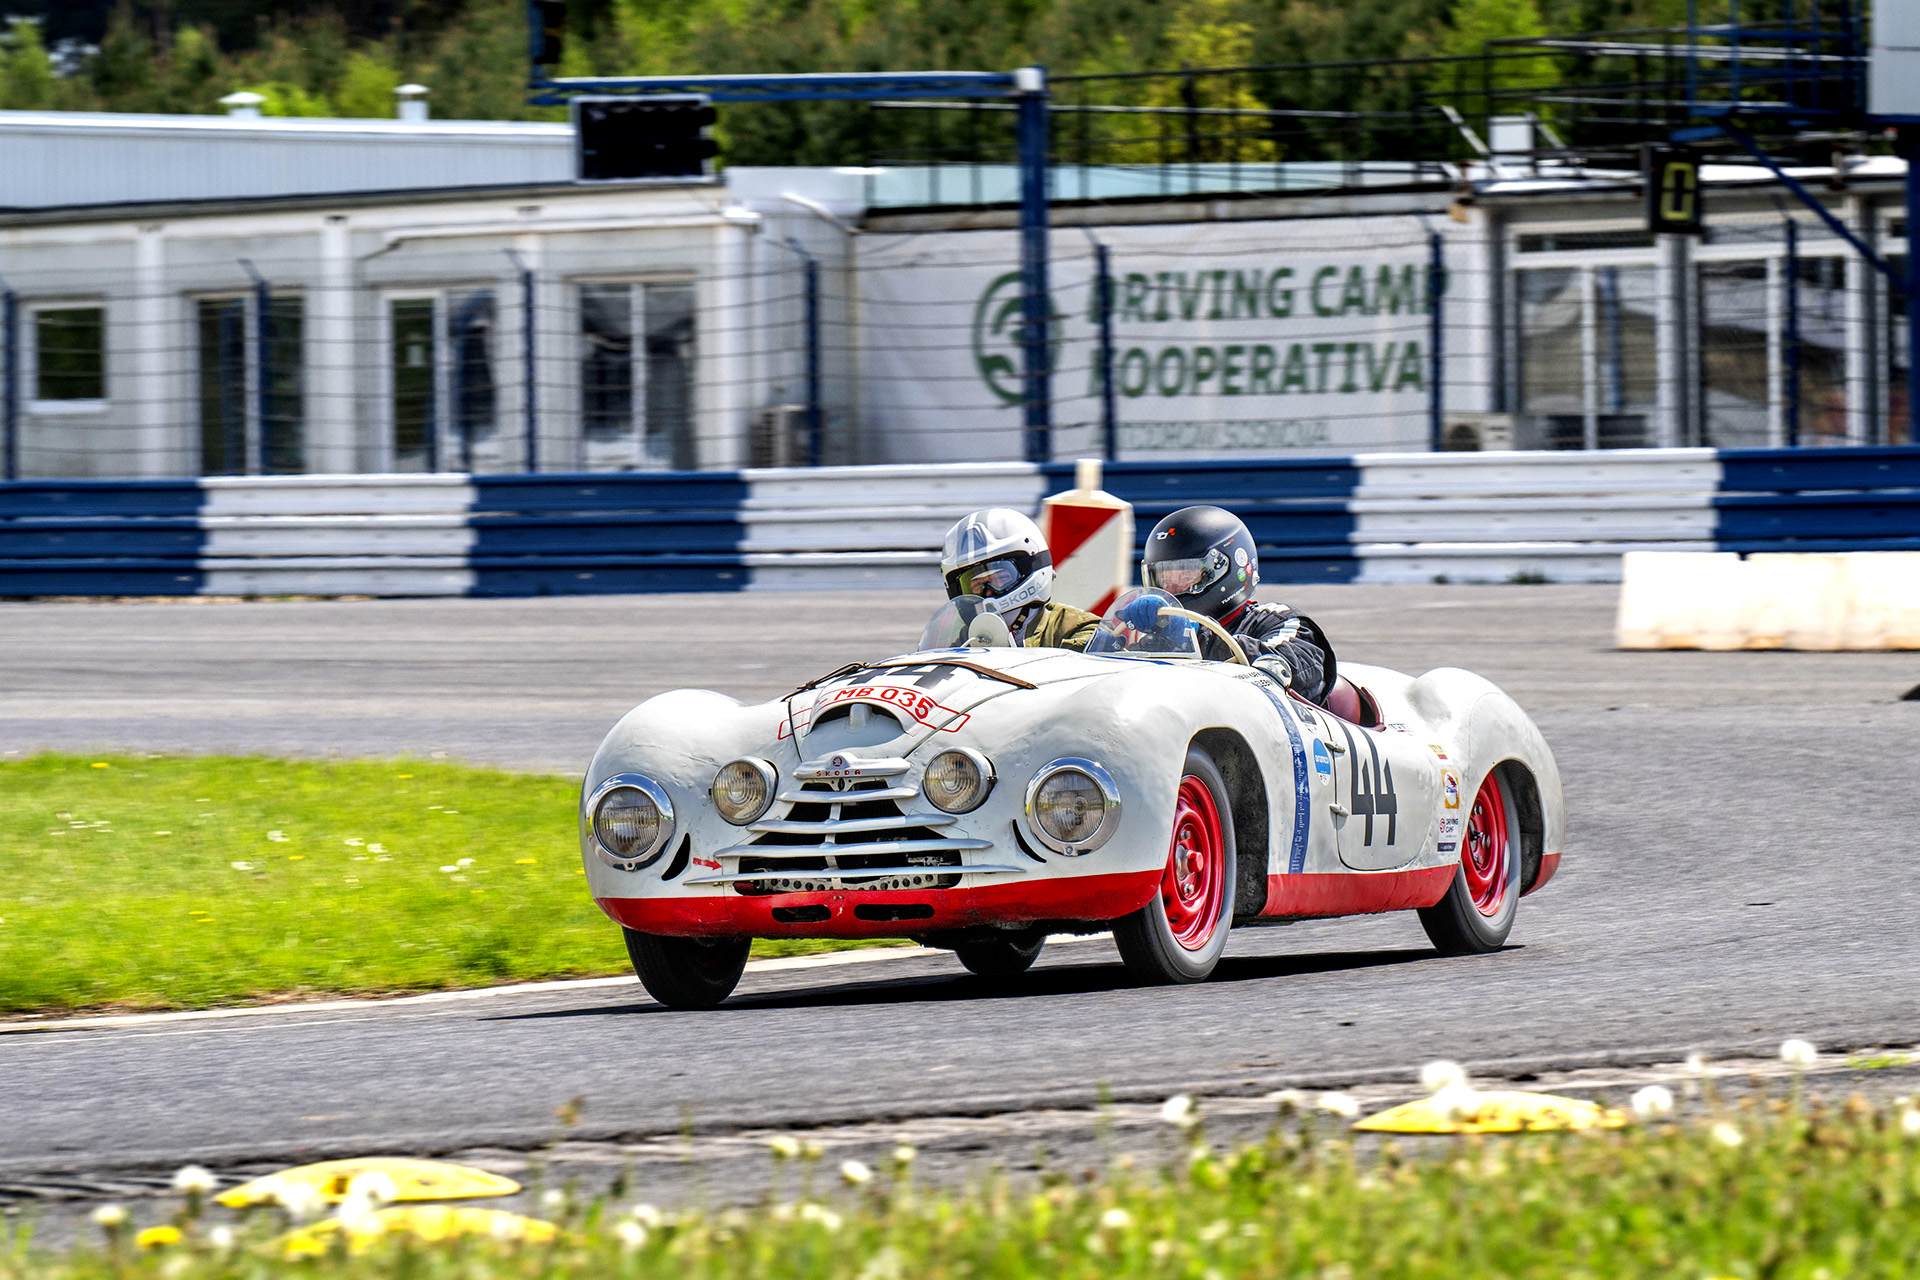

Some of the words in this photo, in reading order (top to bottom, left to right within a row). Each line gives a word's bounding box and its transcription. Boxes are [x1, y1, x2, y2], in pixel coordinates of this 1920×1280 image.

[834, 687, 875, 701] MB
[880, 688, 934, 720] 035
[1335, 719, 1398, 847] 44
